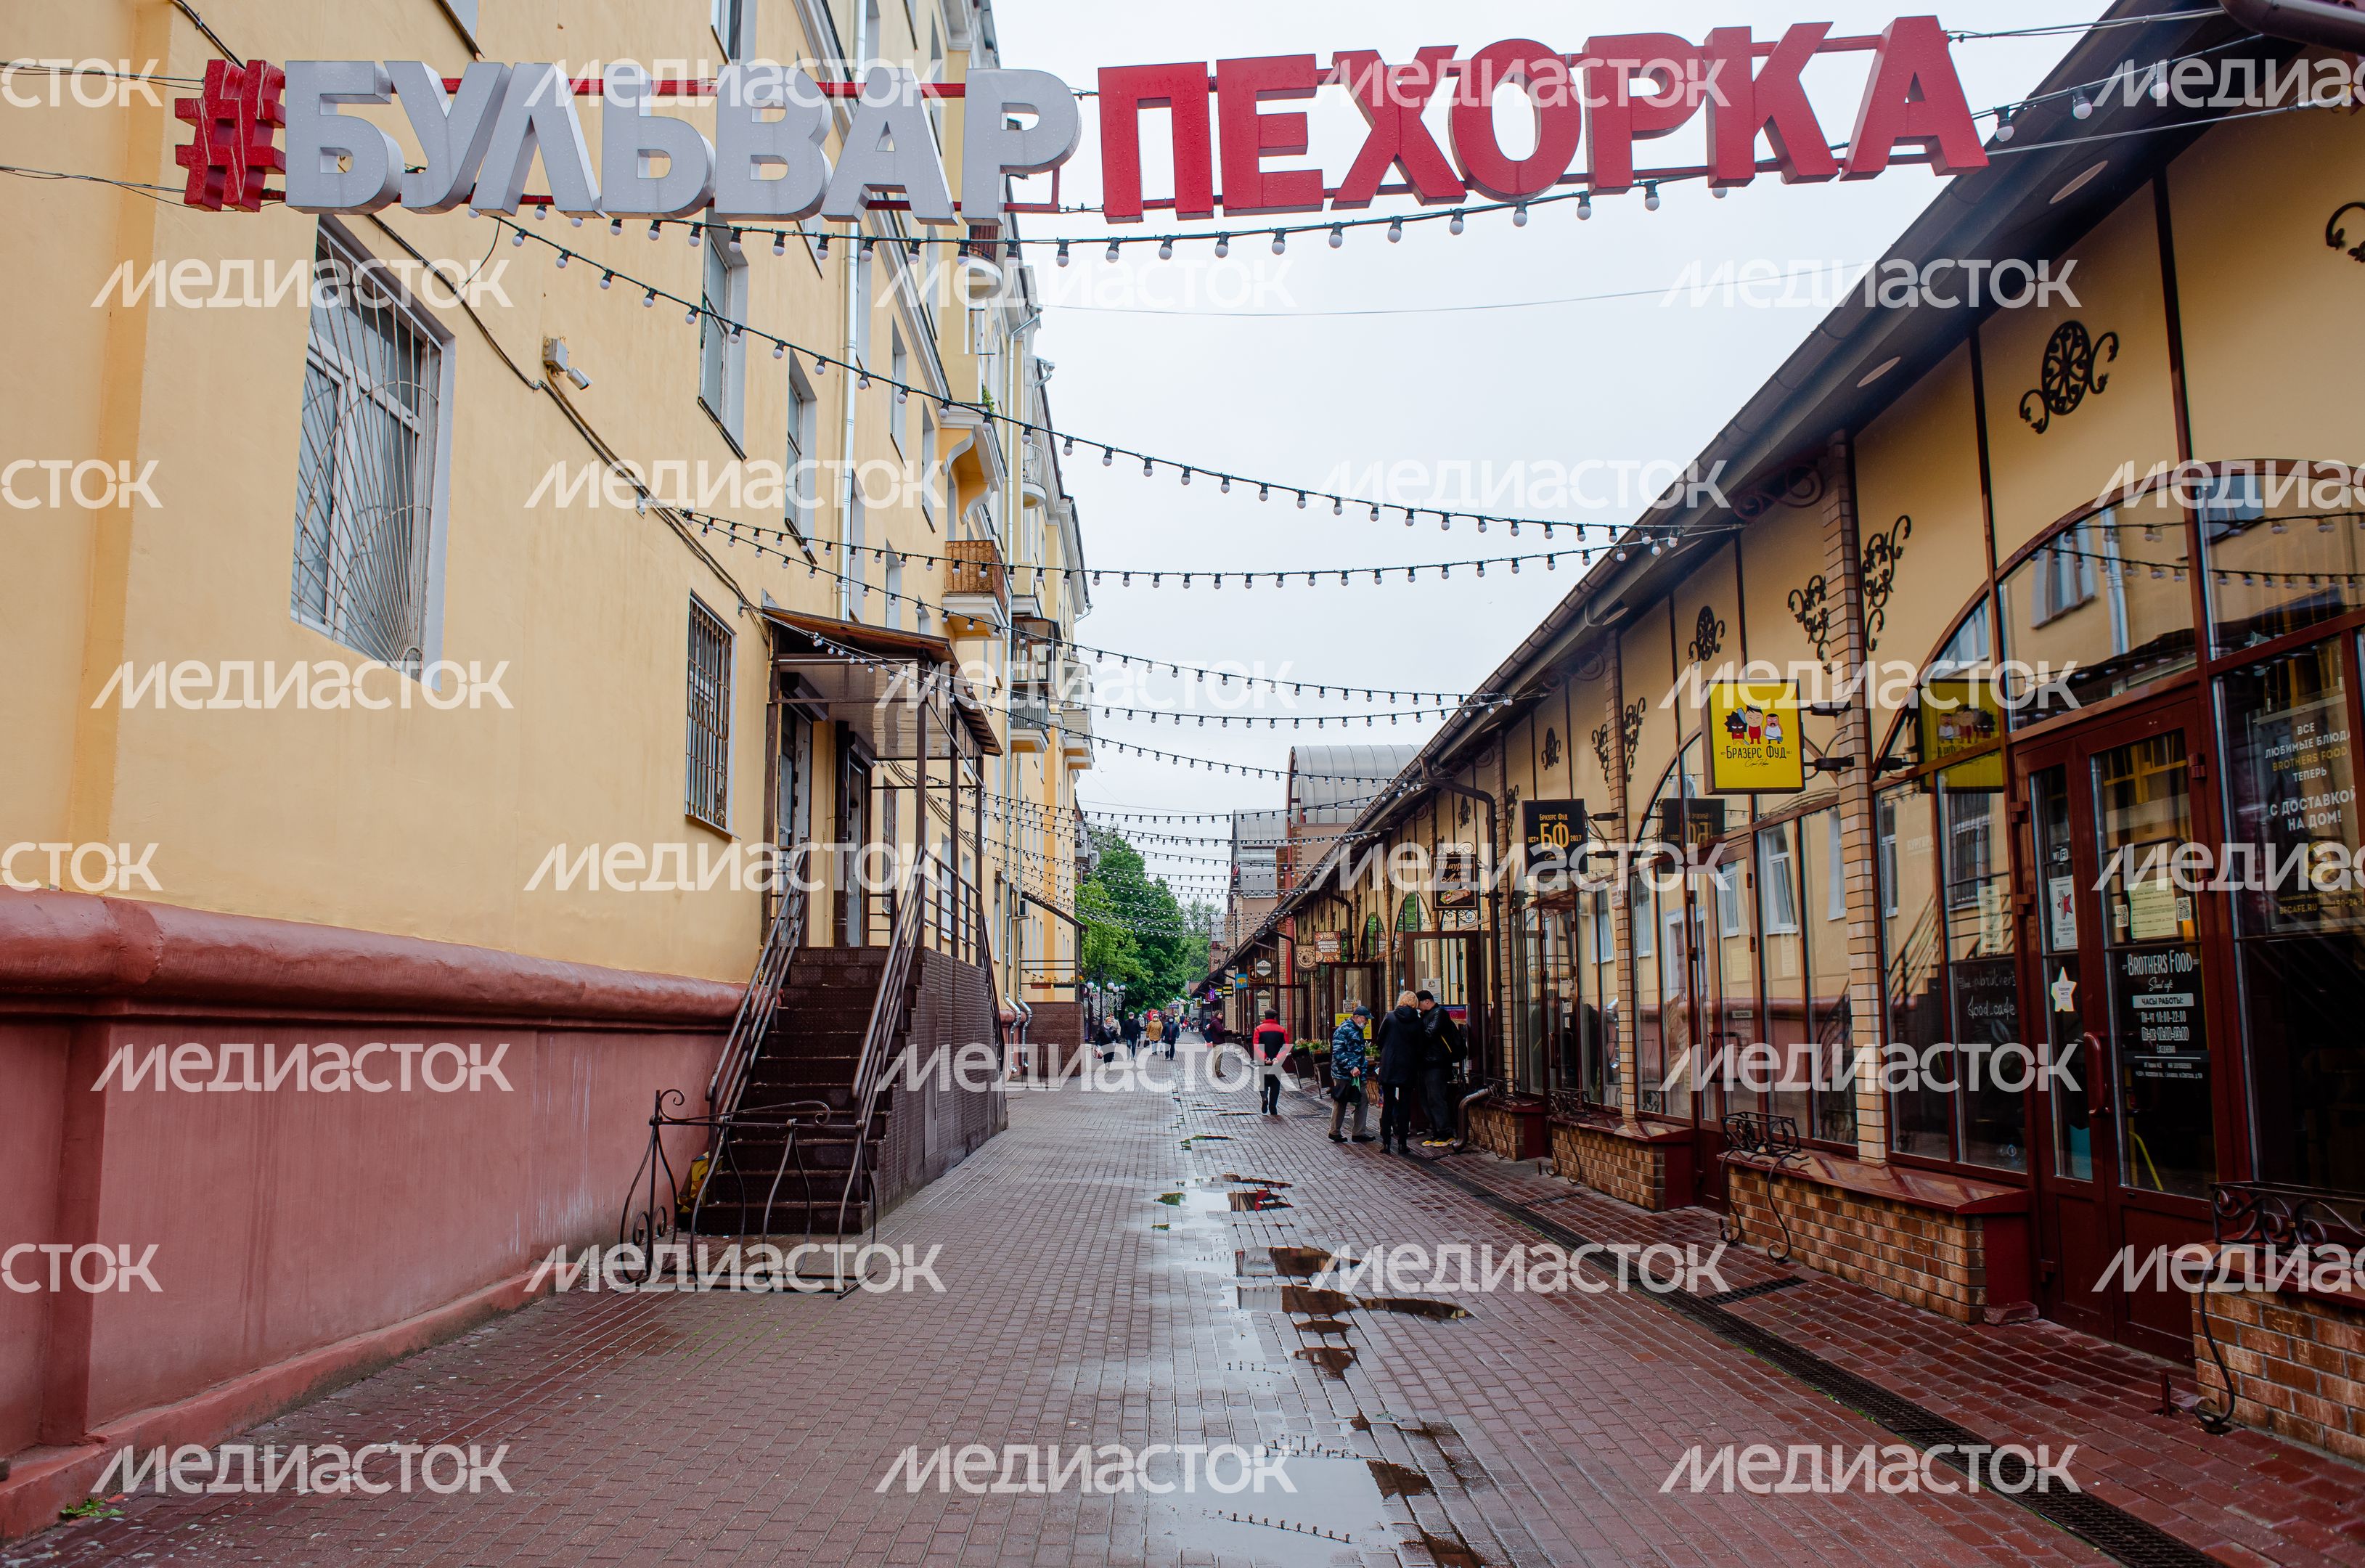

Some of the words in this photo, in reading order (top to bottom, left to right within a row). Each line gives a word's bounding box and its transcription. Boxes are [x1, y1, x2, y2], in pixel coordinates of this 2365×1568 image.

[2297, 722, 2315, 735] ВСЕ
[1726, 746, 1762, 759] БРАЗЕРС
[1766, 745, 1787, 759] ФУД
[2265, 737, 2314, 759] ЛЮБИМЫЕ
[2272, 752, 2319, 772] BROTHERS
[2321, 746, 2348, 761] FOOD
[2292, 767, 2327, 782] ТЕПЕРЬ
[2269, 804, 2278, 816] С
[2288, 817, 2305, 831] НА
[2308, 809, 2342, 830] ДОМ!
[1540, 822, 1569, 850] БФ
[1436, 860, 1473, 871] Шаурма
[2159, 996, 2184, 1005] РАБОТЫ:
